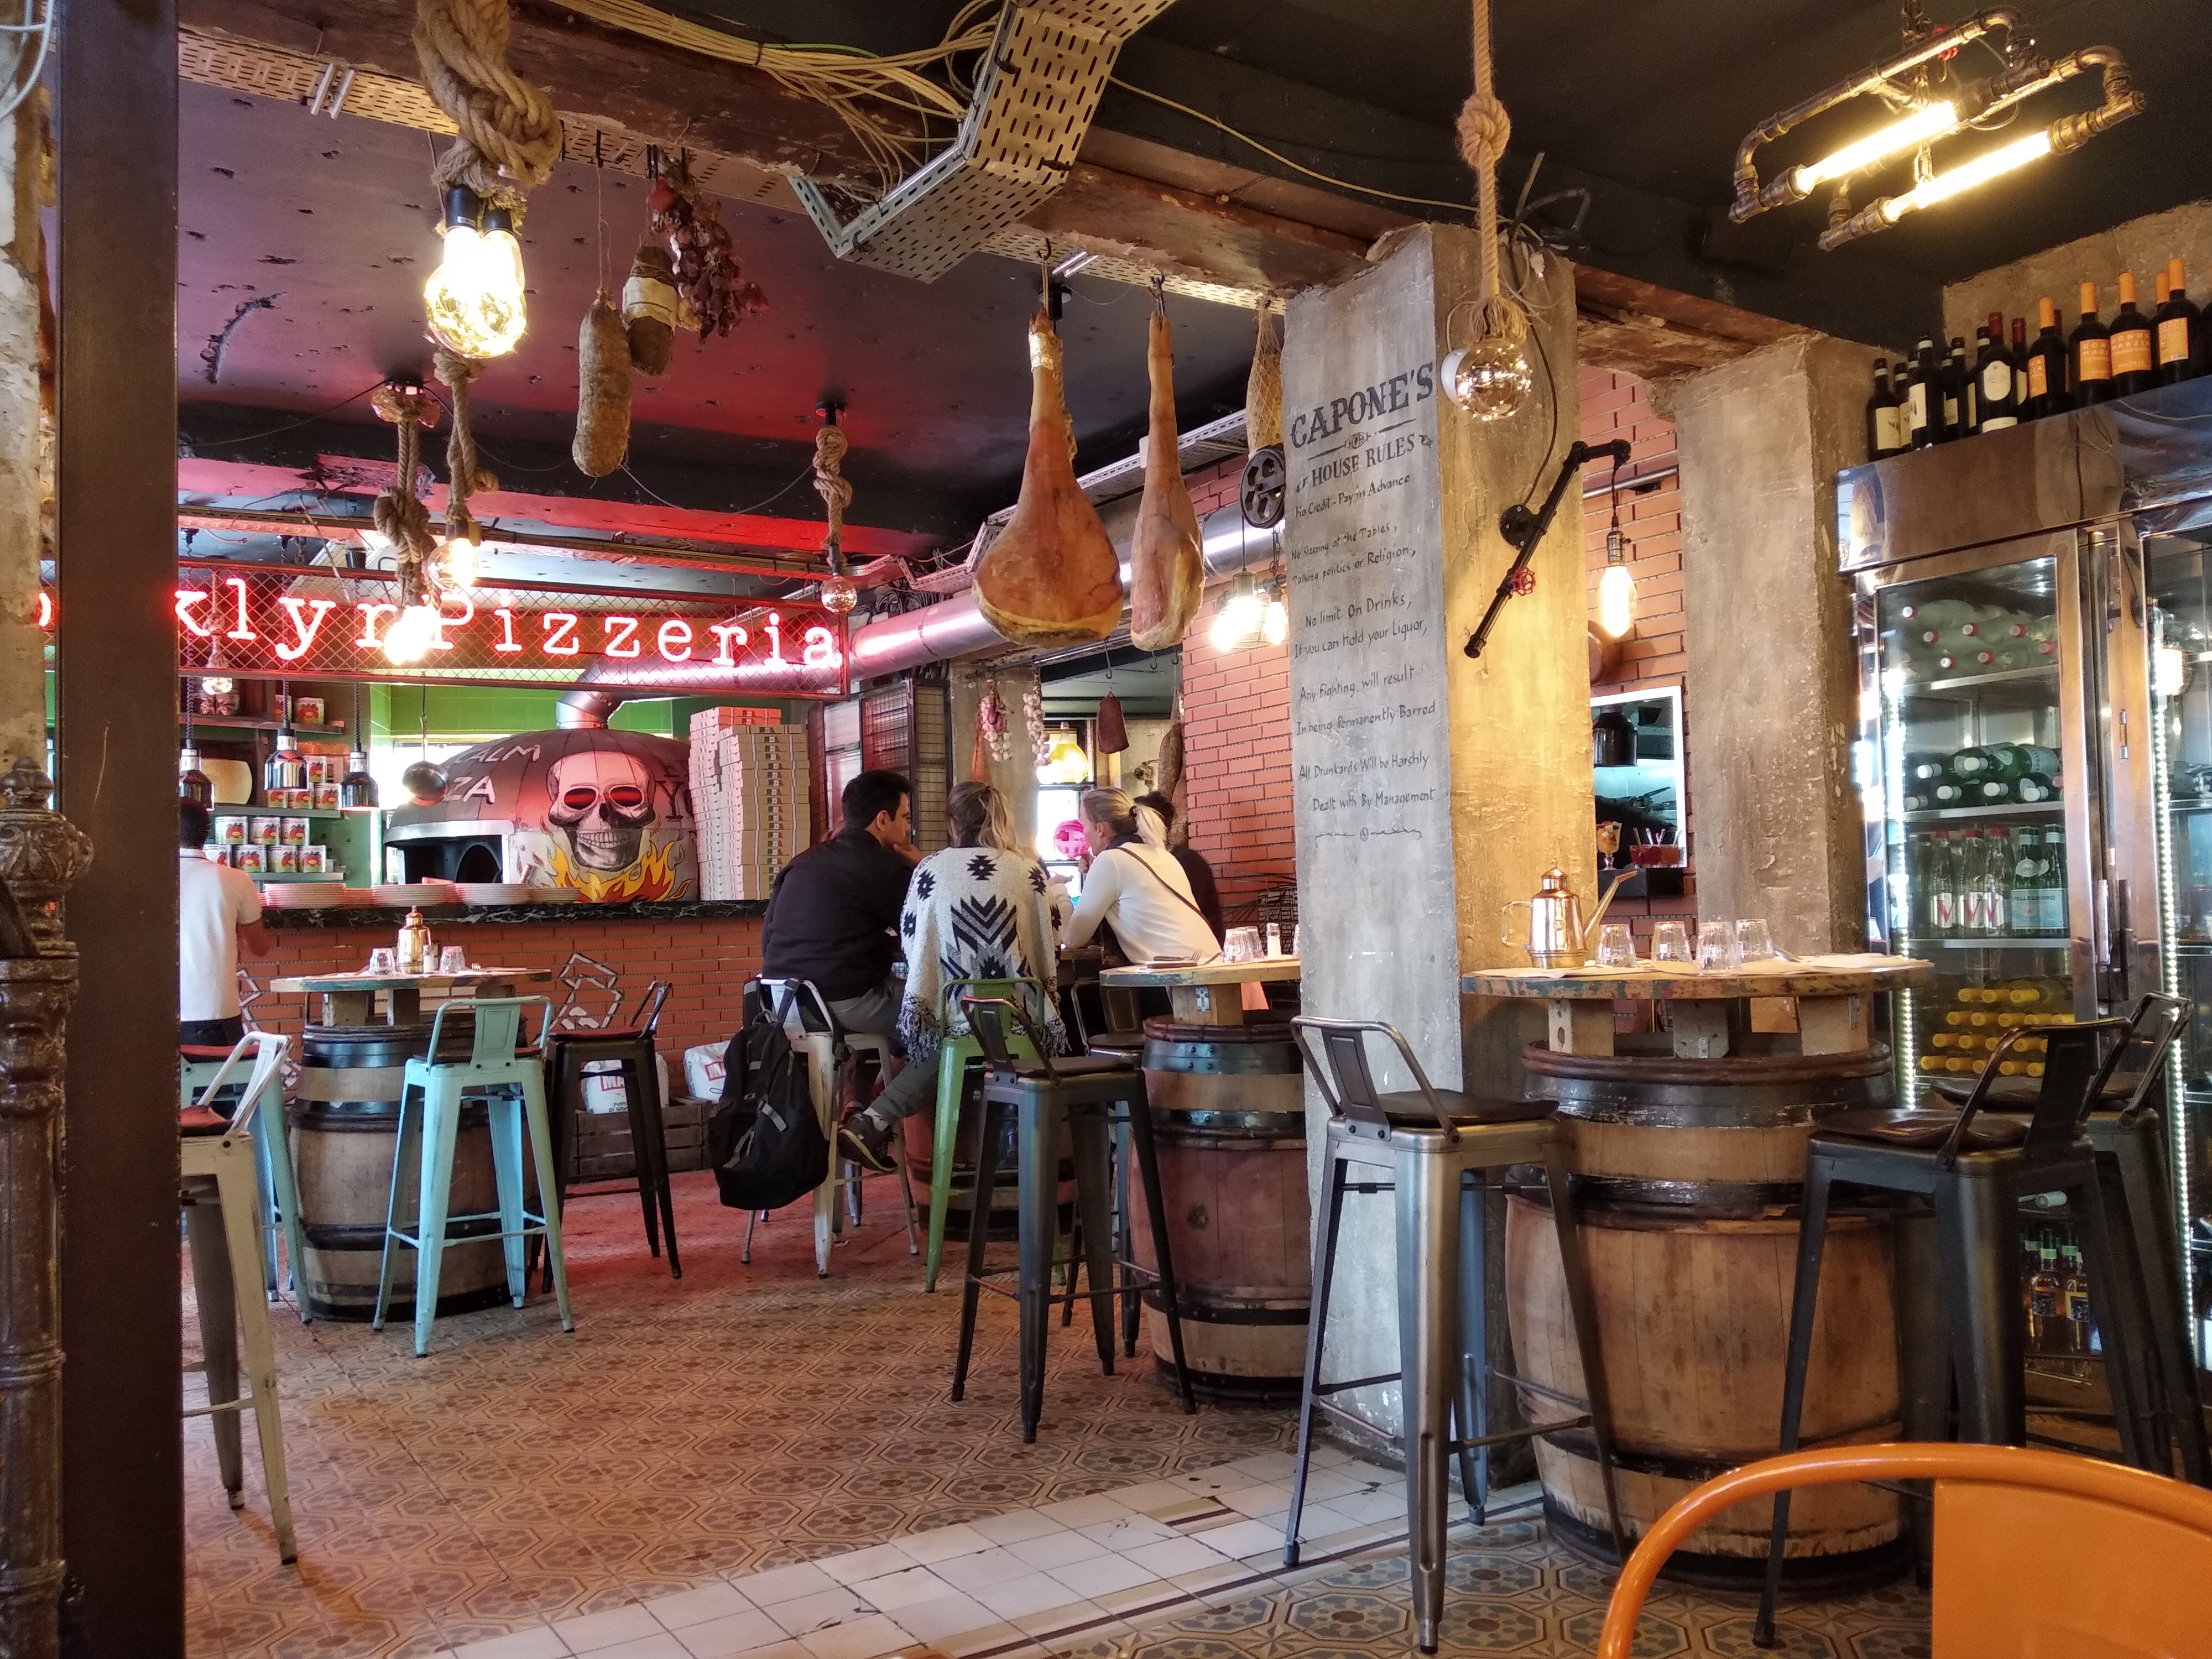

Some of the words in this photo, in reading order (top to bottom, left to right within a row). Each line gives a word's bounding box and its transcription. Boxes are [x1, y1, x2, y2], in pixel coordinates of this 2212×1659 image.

[1290, 361, 1433, 448] CAPONE'S
[1312, 454, 1360, 487] HOUSE
[1365, 432, 1416, 468] RULES
[1296, 505, 1306, 518] No
[1308, 497, 1332, 514] Credit
[1338, 492, 1353, 506] Pay
[1355, 485, 1366, 499] in
[1368, 474, 1411, 497] Advance
[1292, 550, 1301, 560] No
[1332, 535, 1342, 548] at
[1342, 531, 1358, 544] the
[1292, 572, 1319, 585] Talking
[1322, 559, 1351, 581] politics
[1354, 558, 1364, 569] or
[1367, 543, 1417, 566] Religion,
[1306, 614, 1317, 628] No
[1348, 604, 1362, 618] On
[1366, 589, 1412, 613] Drinks,
[420, 593, 843, 668] Pizzeria
[1294, 643, 1302, 659] If
[1305, 644, 1320, 660] you
[1322, 640, 1339, 652] can
[1343, 628, 1364, 647] Hold
[1368, 628, 1389, 648] your
[1392, 619, 1428, 642] Liquor,
[1300, 686, 1316, 703] Any
[1361, 670, 1379, 690] will
[1383, 663, 1415, 686] result
[1296, 721, 1306, 736] In
[1308, 721, 1332, 737] being
[1337, 706, 1396, 729] Permanently
[1399, 700, 1436, 719] Barred
[1298, 765, 1311, 781] All
[1313, 761, 1357, 779] Drunkards
[1359, 755, 1377, 773] Will
[1379, 758, 1389, 769] be
[1391, 750, 1430, 773] Harshly
[1313, 797, 1336, 812] Dealt
[1339, 793, 1357, 808] with
[1361, 792, 1373, 810] By
[1375, 787, 1437, 811] Management
